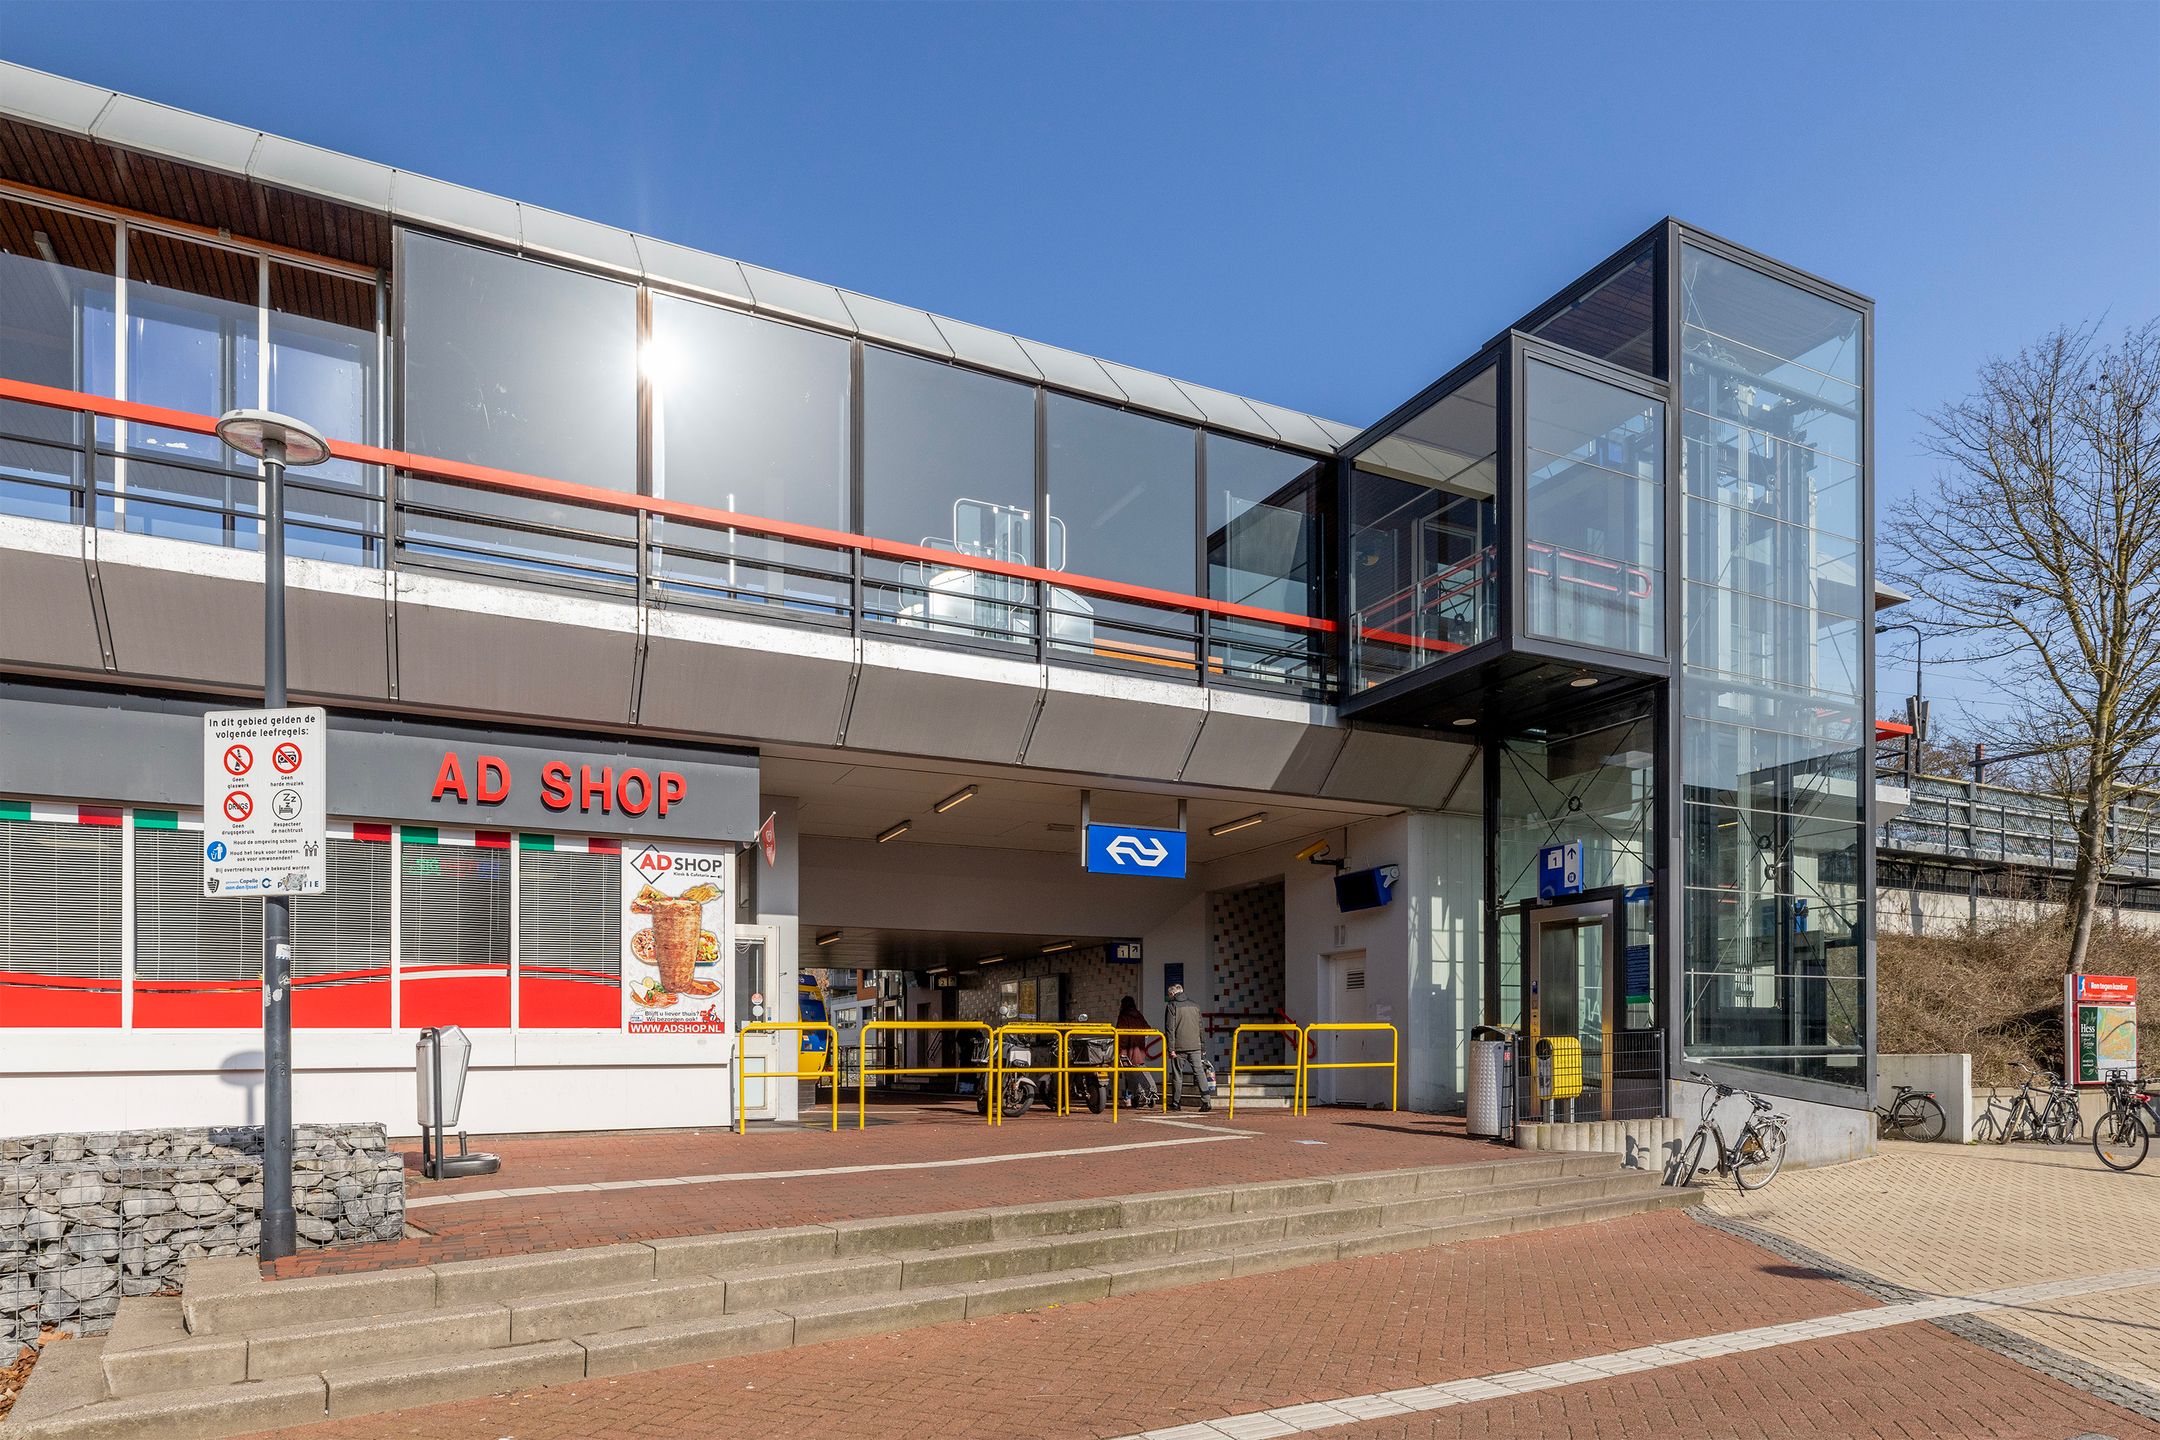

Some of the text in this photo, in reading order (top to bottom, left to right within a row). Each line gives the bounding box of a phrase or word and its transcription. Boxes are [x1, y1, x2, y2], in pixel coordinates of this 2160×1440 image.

[209, 715, 315, 728] In dit gebied gelden de
[216, 727, 308, 740] volgende leefregels:
[432, 752, 687, 816] AD SHOP
[640, 854, 722, 872] AD SHOP
[1553, 857, 1558, 866] 1
[630, 1024, 721, 1033] WWW.ADSHOP.NL
[2081, 1024, 2095, 1033] Hess
